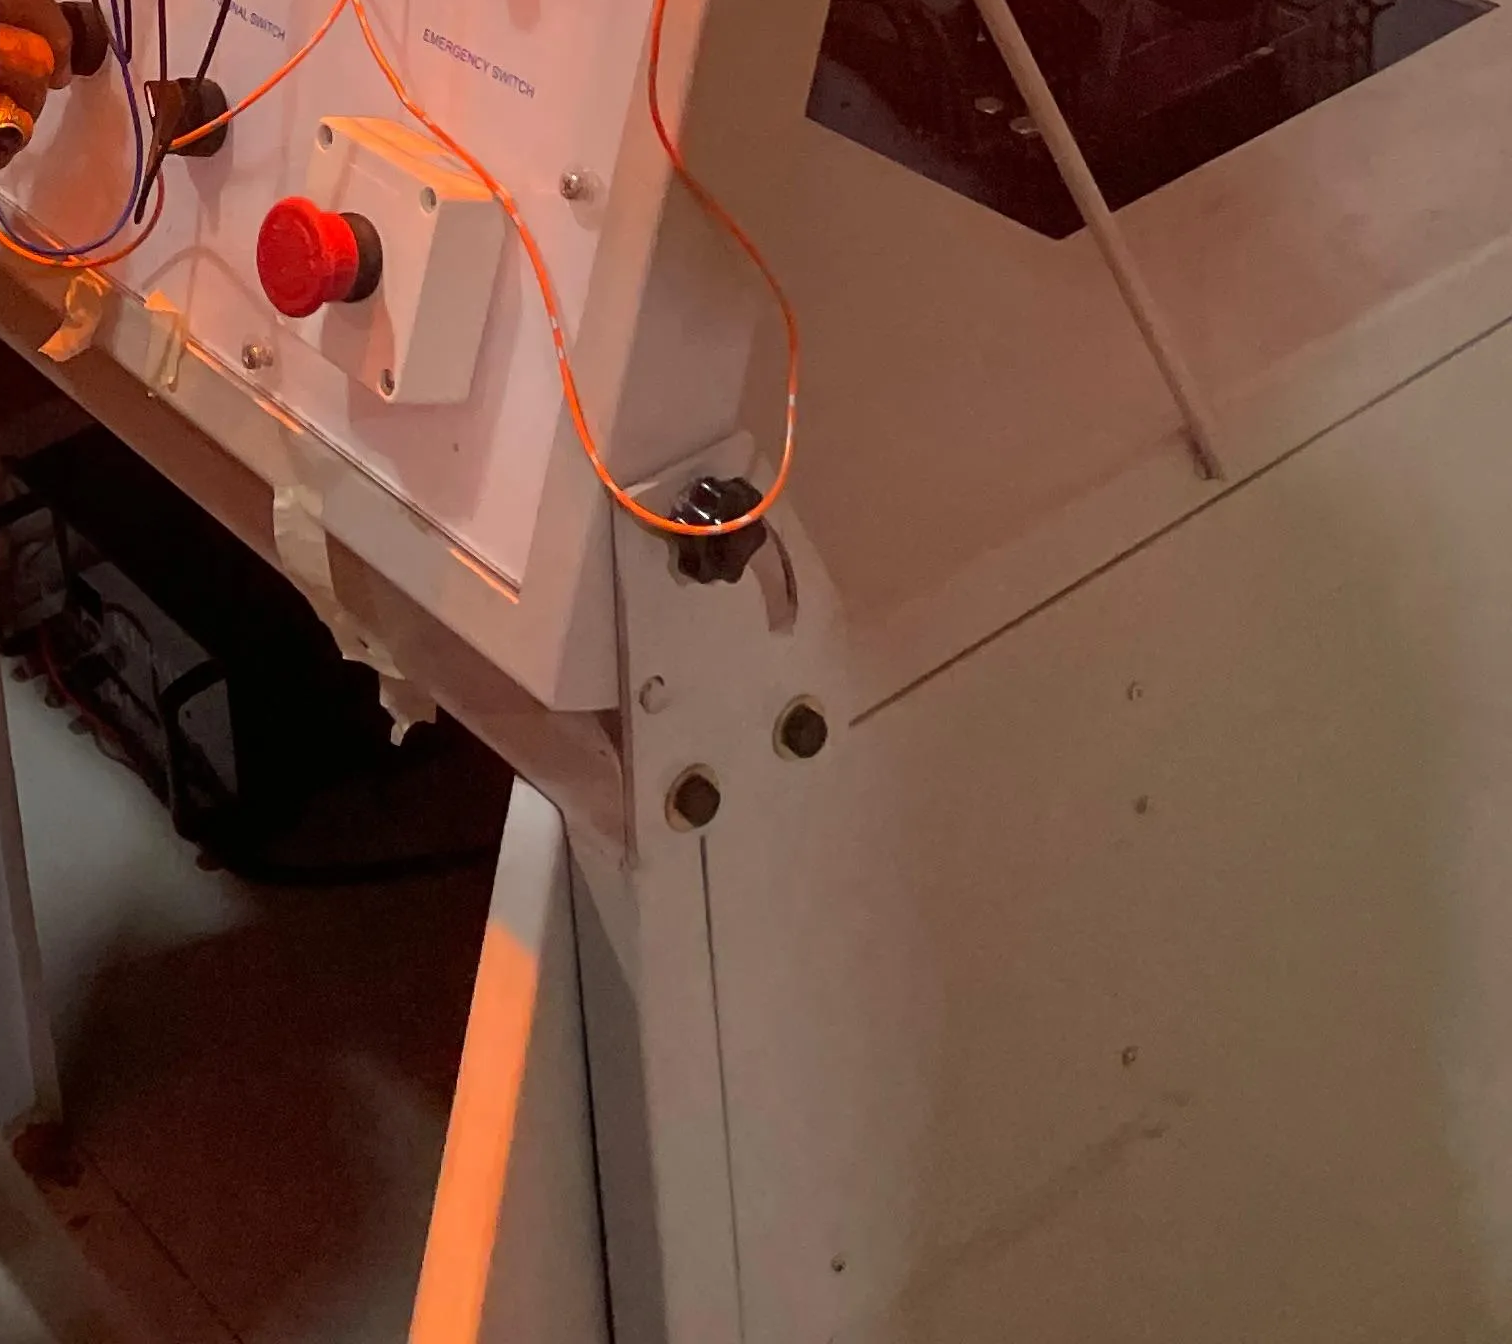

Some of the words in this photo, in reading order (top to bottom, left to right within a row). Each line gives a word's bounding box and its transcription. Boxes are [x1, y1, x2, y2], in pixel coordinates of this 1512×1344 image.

[250, 12, 286, 42] SWITCH
[422, 28, 491, 74] EMERGENCY
[491, 64, 535, 99] SWITCH
